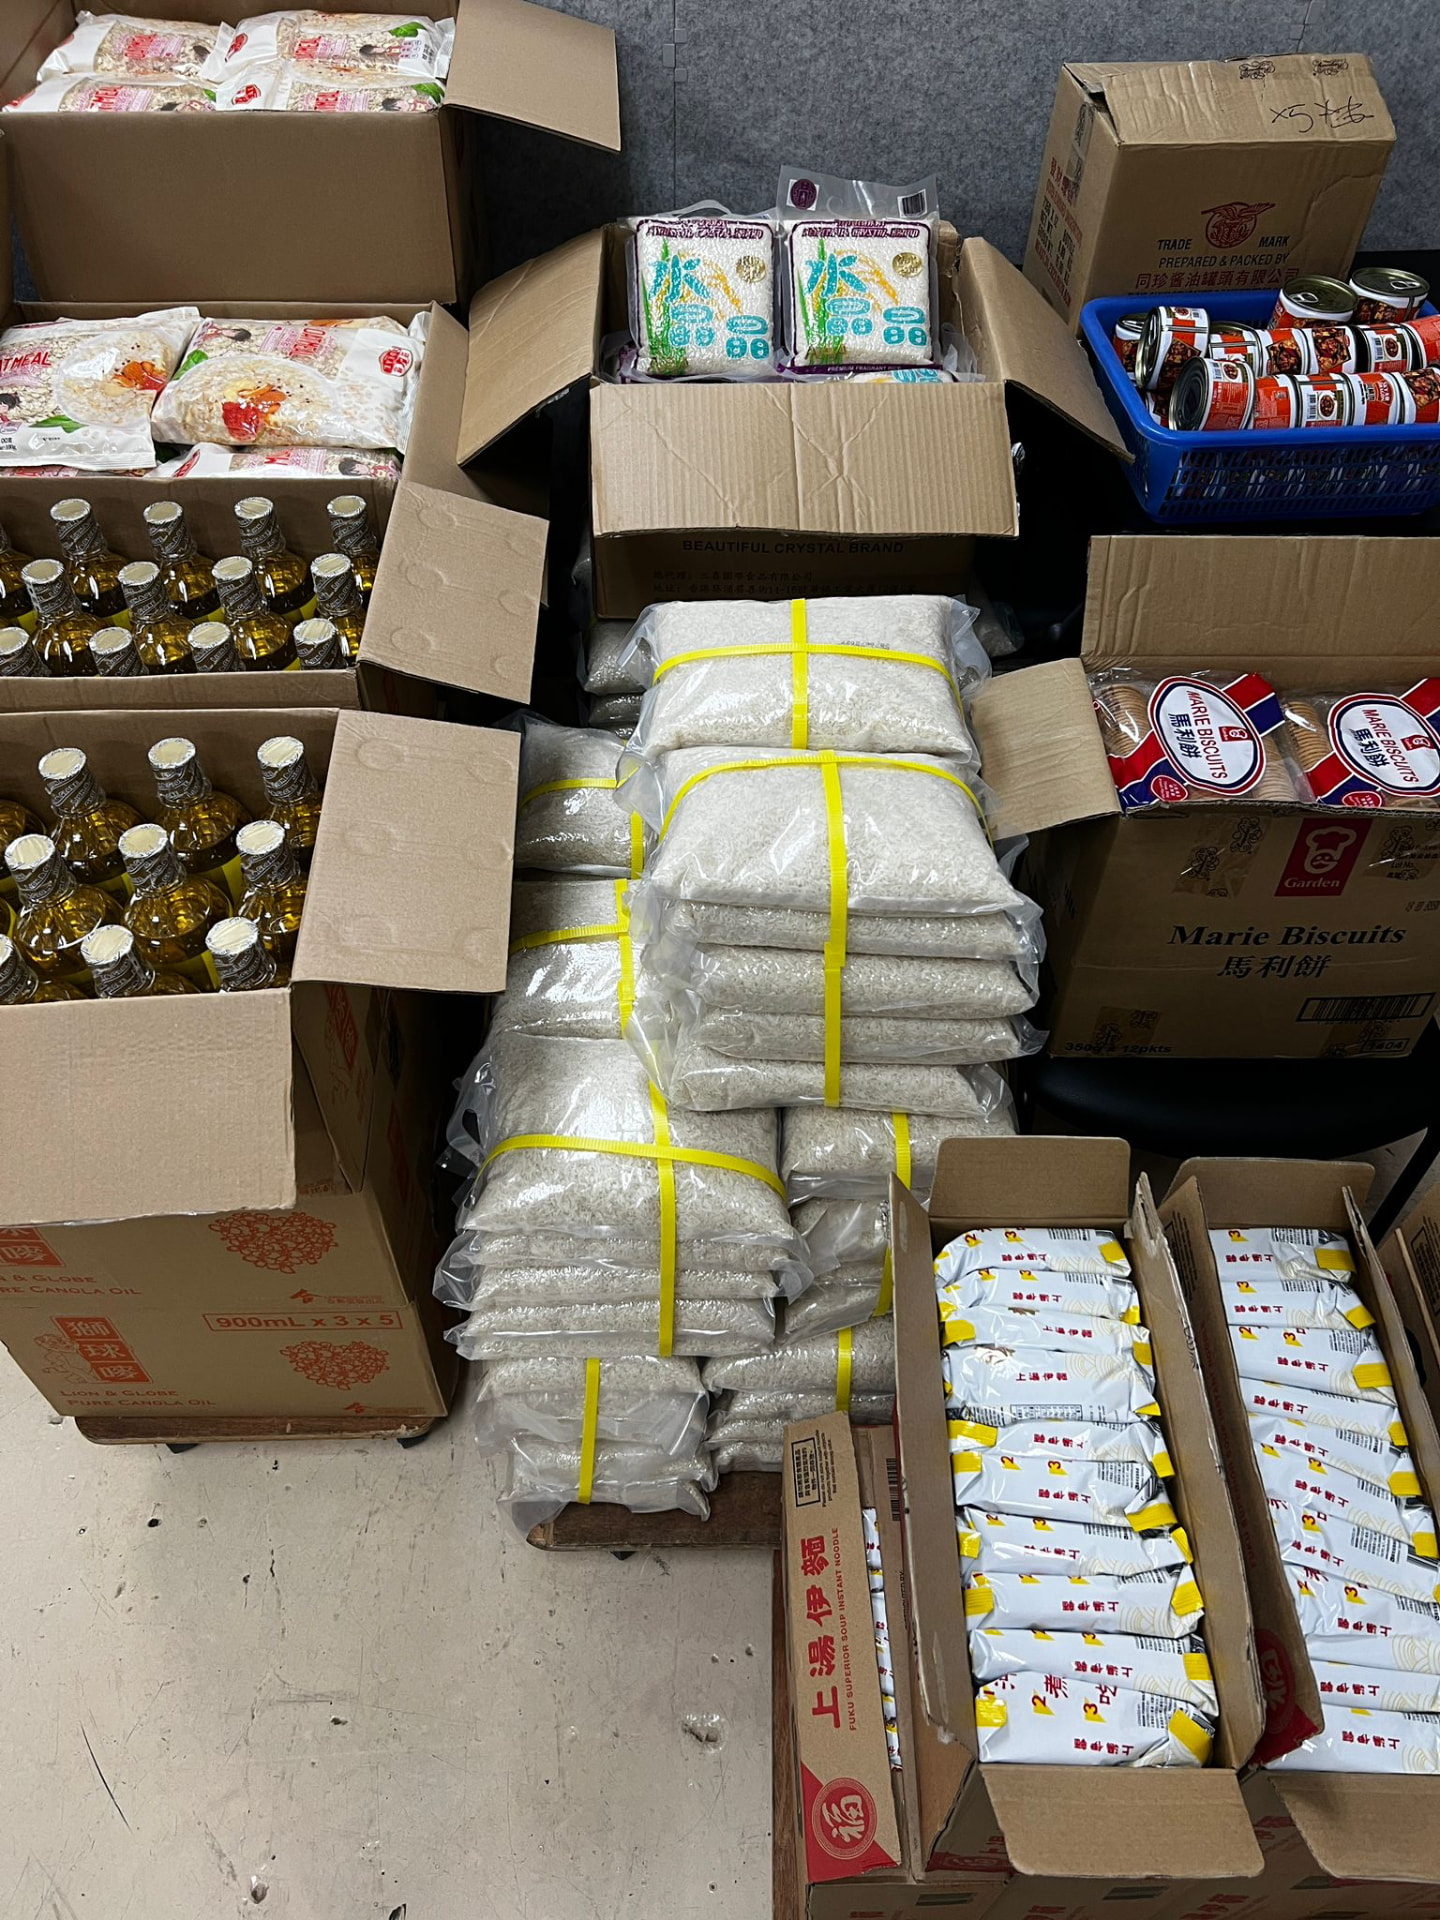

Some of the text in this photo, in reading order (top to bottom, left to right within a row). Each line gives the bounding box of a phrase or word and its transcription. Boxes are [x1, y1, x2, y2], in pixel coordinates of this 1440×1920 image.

[1157, 235, 1291, 251] TRADE MARK
[1159, 252, 1290, 269] PREPARED & PACKED BY
[0, 351, 51, 371] ATMEAL
[682, 540, 904, 553] BEAUTIFUL CRYSTAL BRAND
[1168, 713, 1203, 758] 馬利餅
[1186, 690, 1228, 779] MARIE BISCUITS
[1348, 728, 1391, 768] 馬利餅
[1362, 709, 1420, 783] MARIE BISCUITS
[1284, 877, 1341, 889] Garden
[1167, 924, 1408, 946] Marie Biscuits
[1217, 954, 1333, 979] 馬利餅
[1122, 1041, 1172, 1055] 12pkts
[1004, 1230, 1018, 1239] 3
[216, 1315, 394, 1328] 900mL x 3 x 5
[1283, 1332, 1296, 1341] 3
[67, 1321, 138, 1379] 獅球嘜
[1048, 1460, 1061, 1470] 3
[1301, 1515, 1316, 1525] 3
[1344, 1585, 1358, 1597] 3
[800, 1535, 841, 1729] 上湯伊麵
[831, 1527, 857, 1731] FUKU SUPERIOR SOUP INSTANT NOODLE
[1031, 1695, 1047, 1708] 2
[1083, 1703, 1098, 1715] 3
